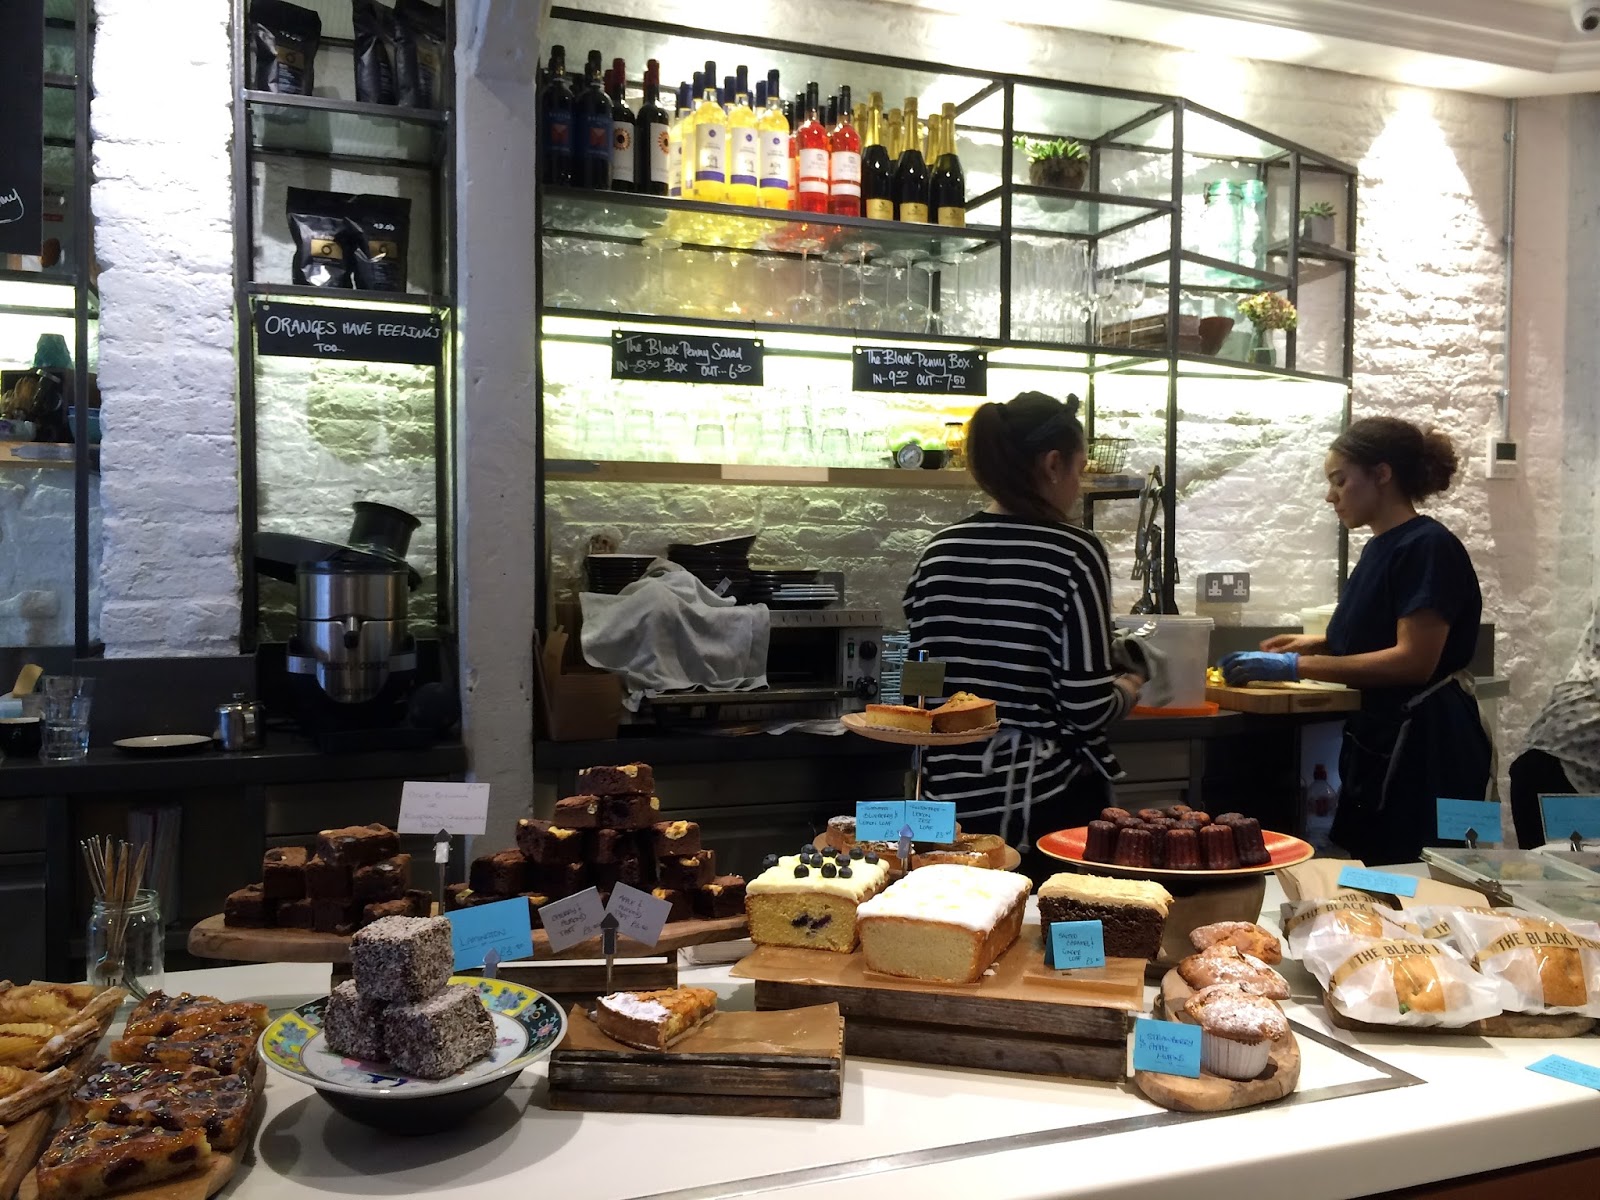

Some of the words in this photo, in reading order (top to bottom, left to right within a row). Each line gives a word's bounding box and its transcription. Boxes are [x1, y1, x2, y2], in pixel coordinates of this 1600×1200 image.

[265, 316, 337, 340] ORANGES
[342, 322, 372, 336] HAVE
[377, 323, 441, 339] FEELINGS
[617, 335, 643, 354] The
[645, 338, 679, 356] Black
[679, 341, 710, 366] Penny
[712, 343, 743, 360] Salad
[863, 349, 884, 365] The
[882, 350, 915, 365] Black
[913, 351, 947, 378] Penny
[1325, 902, 1368, 912] BLACK
[1432, 921, 1451, 934] TH
[1496, 932, 1524, 952] THE
[1525, 931, 1573, 946] BLACK
[1353, 948, 1382, 965] THE
[1386, 943, 1430, 956] BLACK
